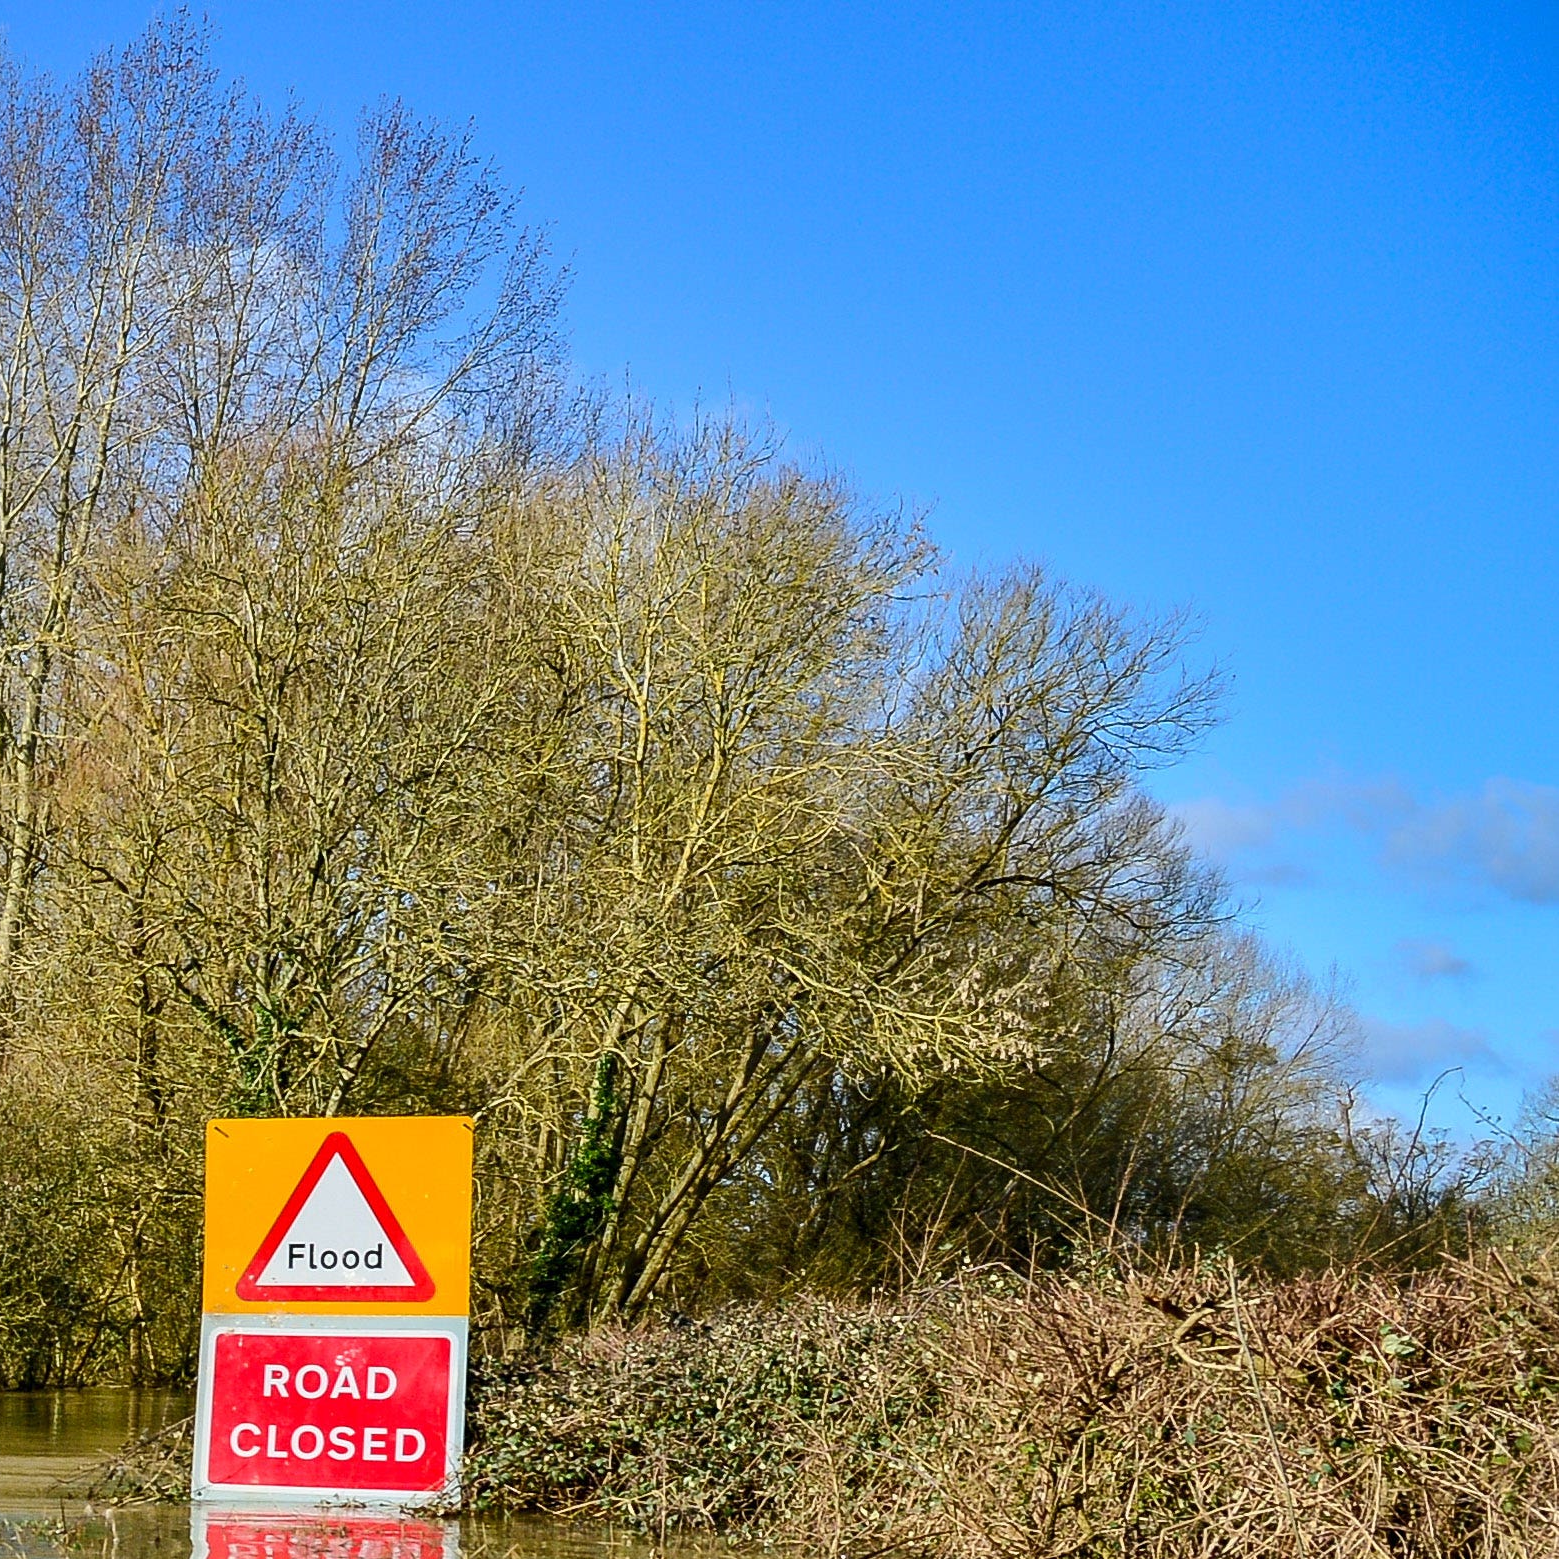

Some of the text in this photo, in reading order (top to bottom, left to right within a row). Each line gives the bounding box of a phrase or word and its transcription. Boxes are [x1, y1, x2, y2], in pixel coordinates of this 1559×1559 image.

[287, 1243, 383, 1270] Flood
[263, 1364, 398, 1400] ROAD
[229, 1423, 426, 1463] CLOSED
